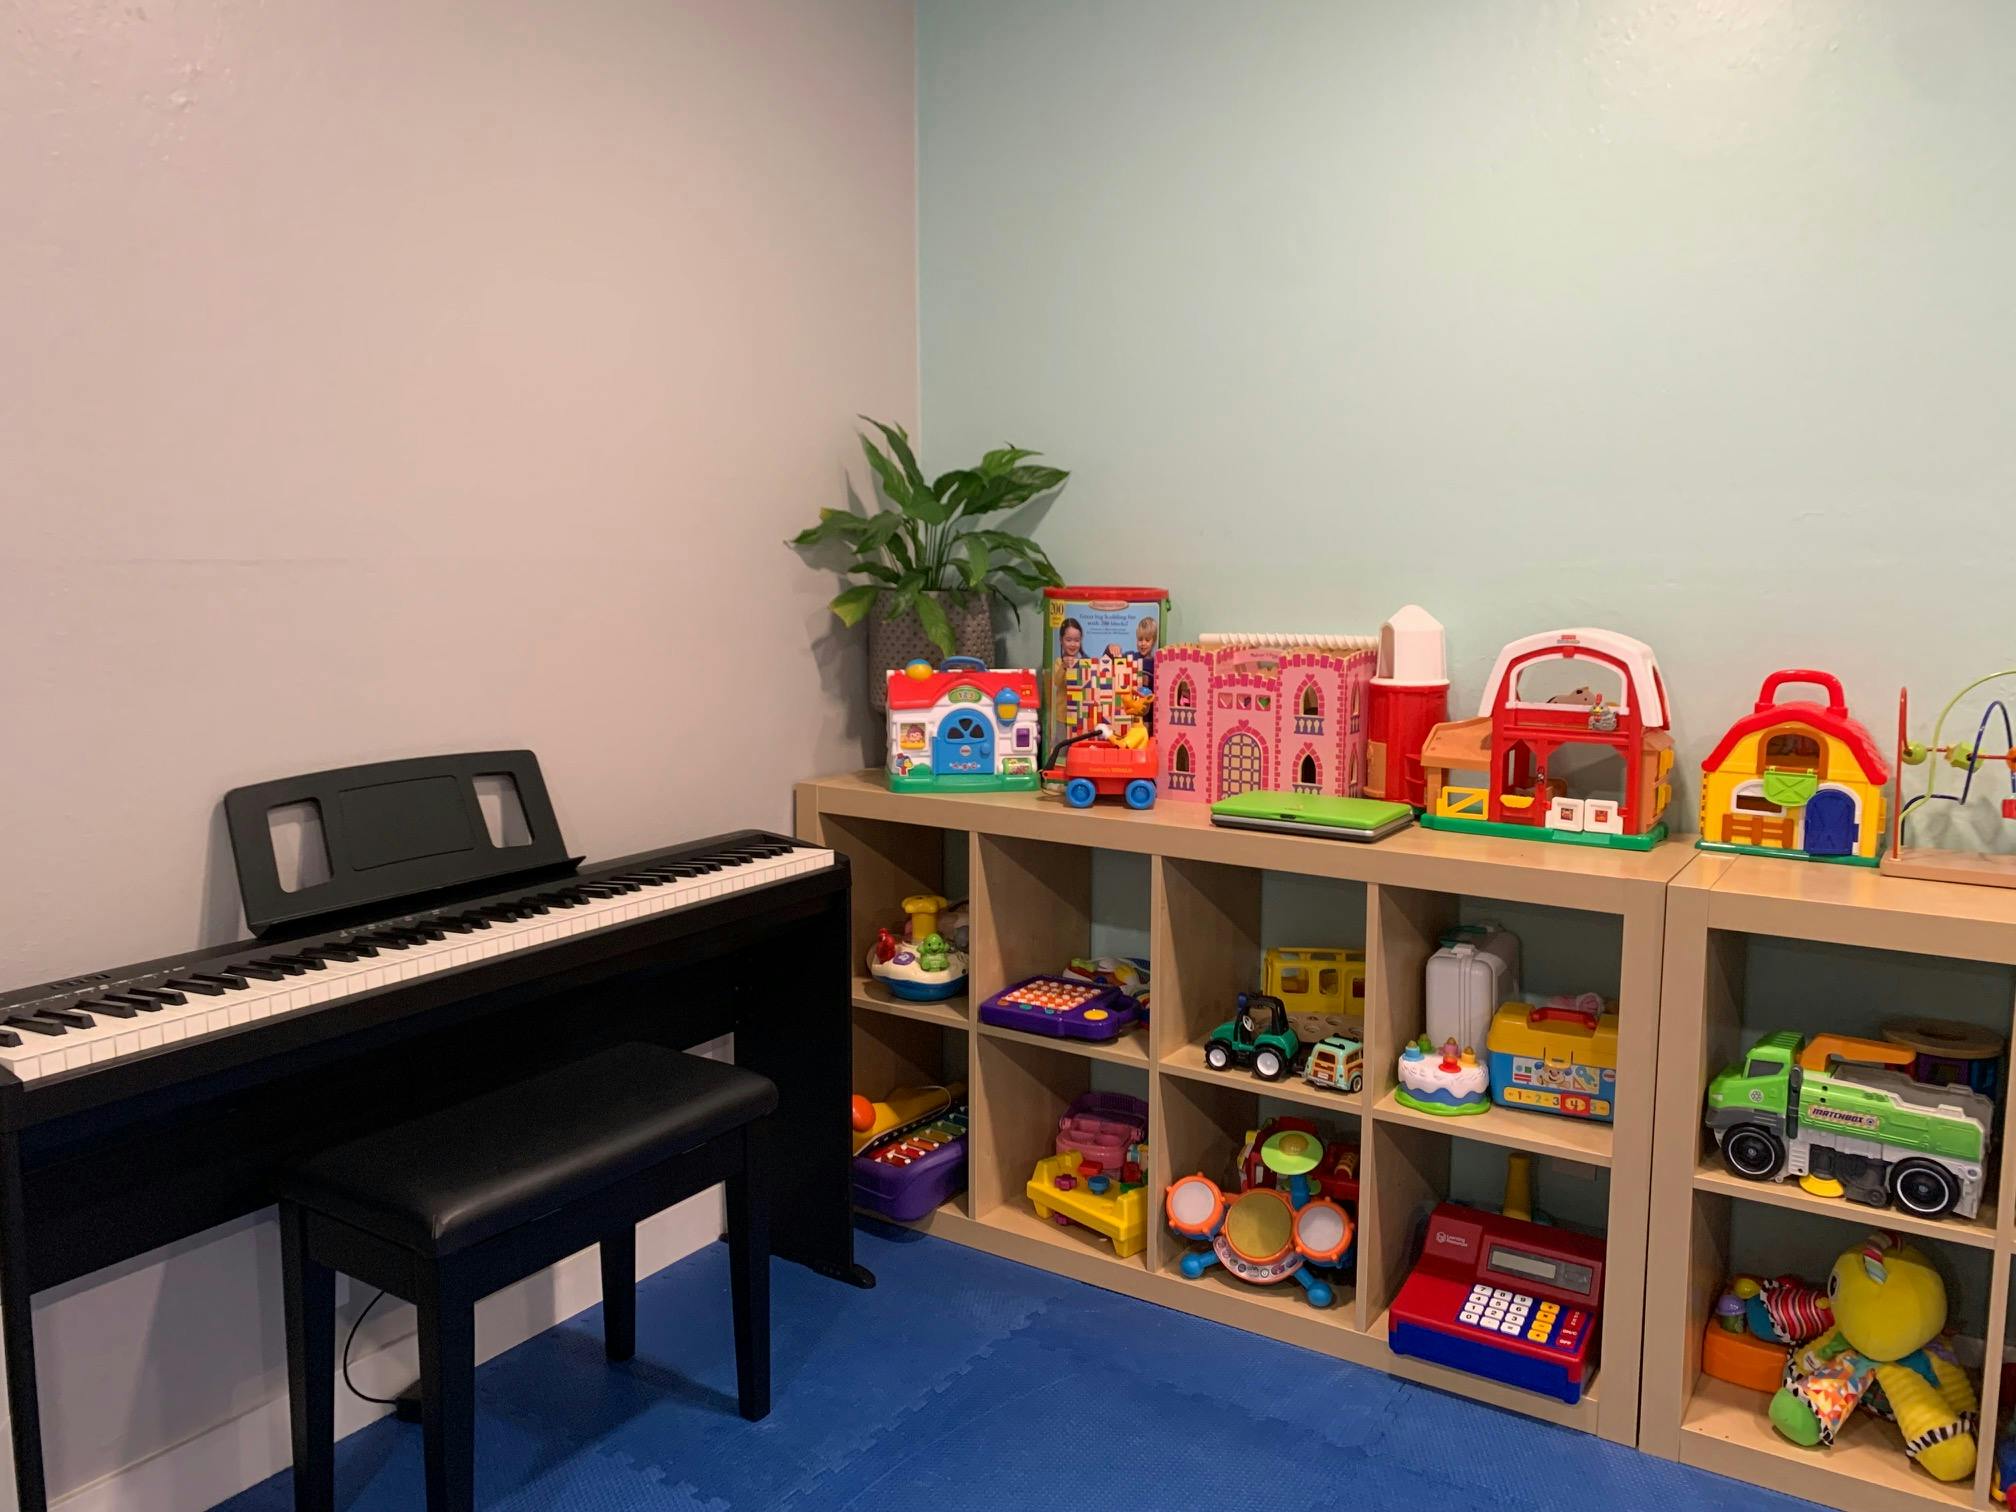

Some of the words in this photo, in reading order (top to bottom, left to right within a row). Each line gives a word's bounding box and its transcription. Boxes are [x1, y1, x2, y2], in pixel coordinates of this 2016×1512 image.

[1050, 601, 1065, 616] 200
[1553, 1096, 1560, 1106] 3
[1570, 1100, 1578, 1109] 4
[1812, 1108, 1864, 1123] MATCHBOX
